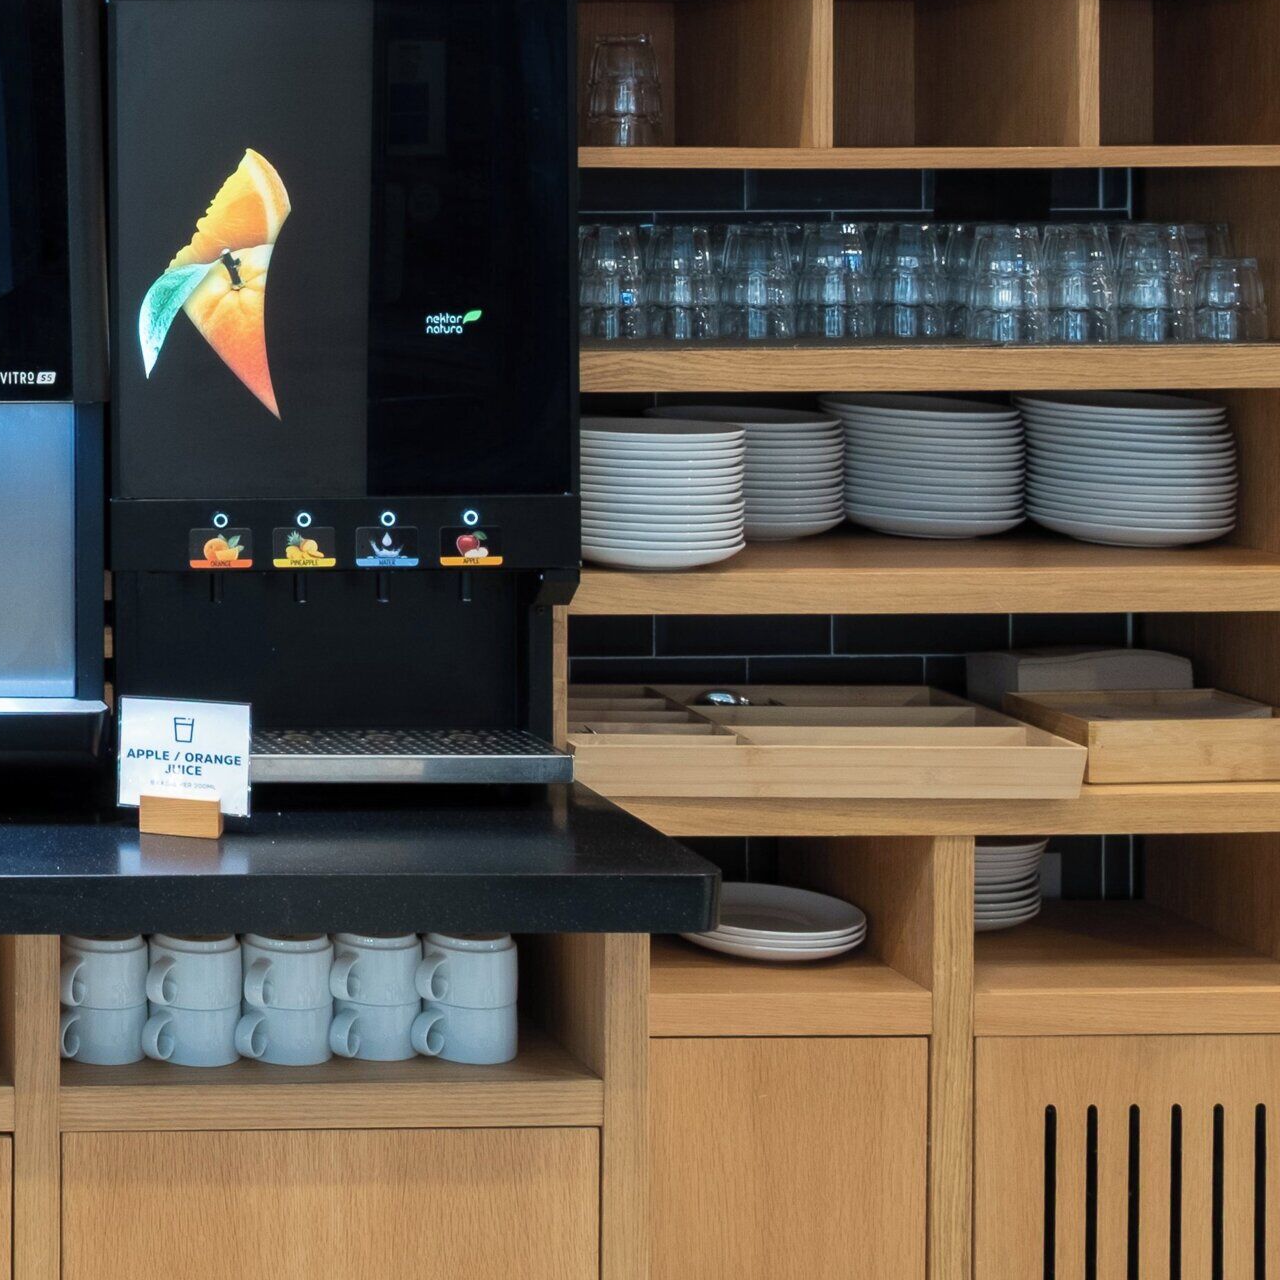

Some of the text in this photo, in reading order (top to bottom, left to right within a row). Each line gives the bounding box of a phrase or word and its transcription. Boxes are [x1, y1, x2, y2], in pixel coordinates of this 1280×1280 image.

[426, 312, 462, 324] nektar
[426, 325, 463, 334] natura
[126, 748, 241, 766] APPLE / ORANGE
